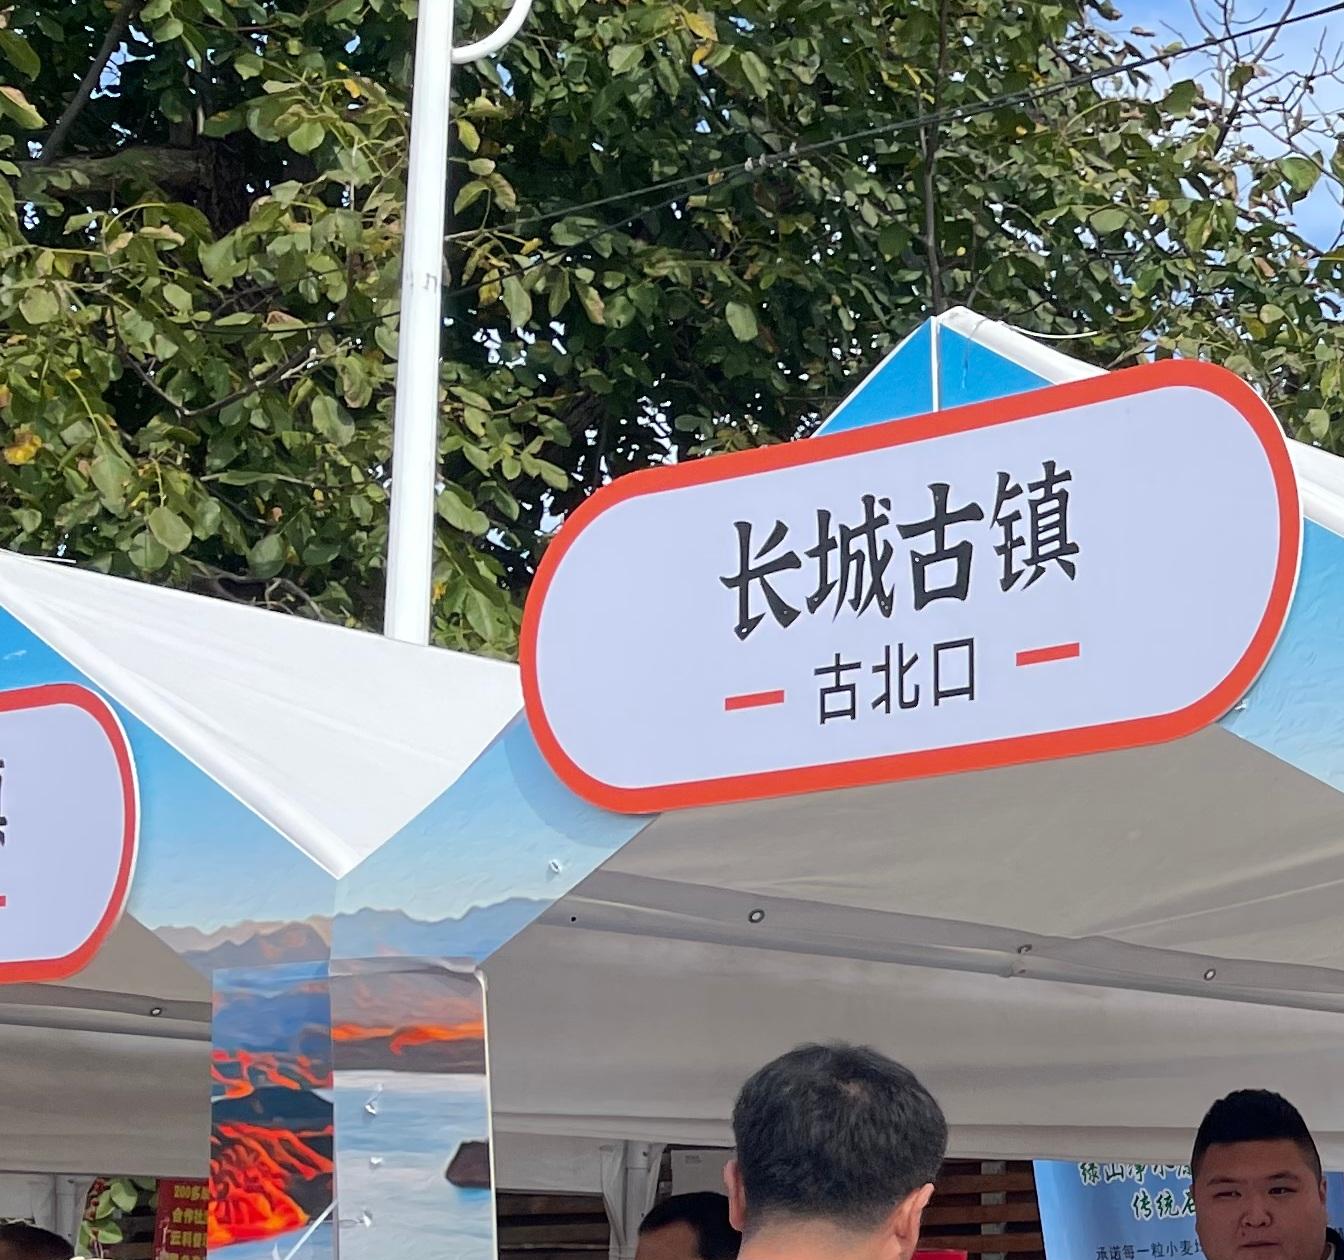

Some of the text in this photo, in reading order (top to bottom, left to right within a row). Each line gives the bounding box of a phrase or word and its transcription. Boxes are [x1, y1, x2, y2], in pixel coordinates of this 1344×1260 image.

[719, 460, 1080, 641] 长城古镇
[813, 637, 976, 725] 古北口
